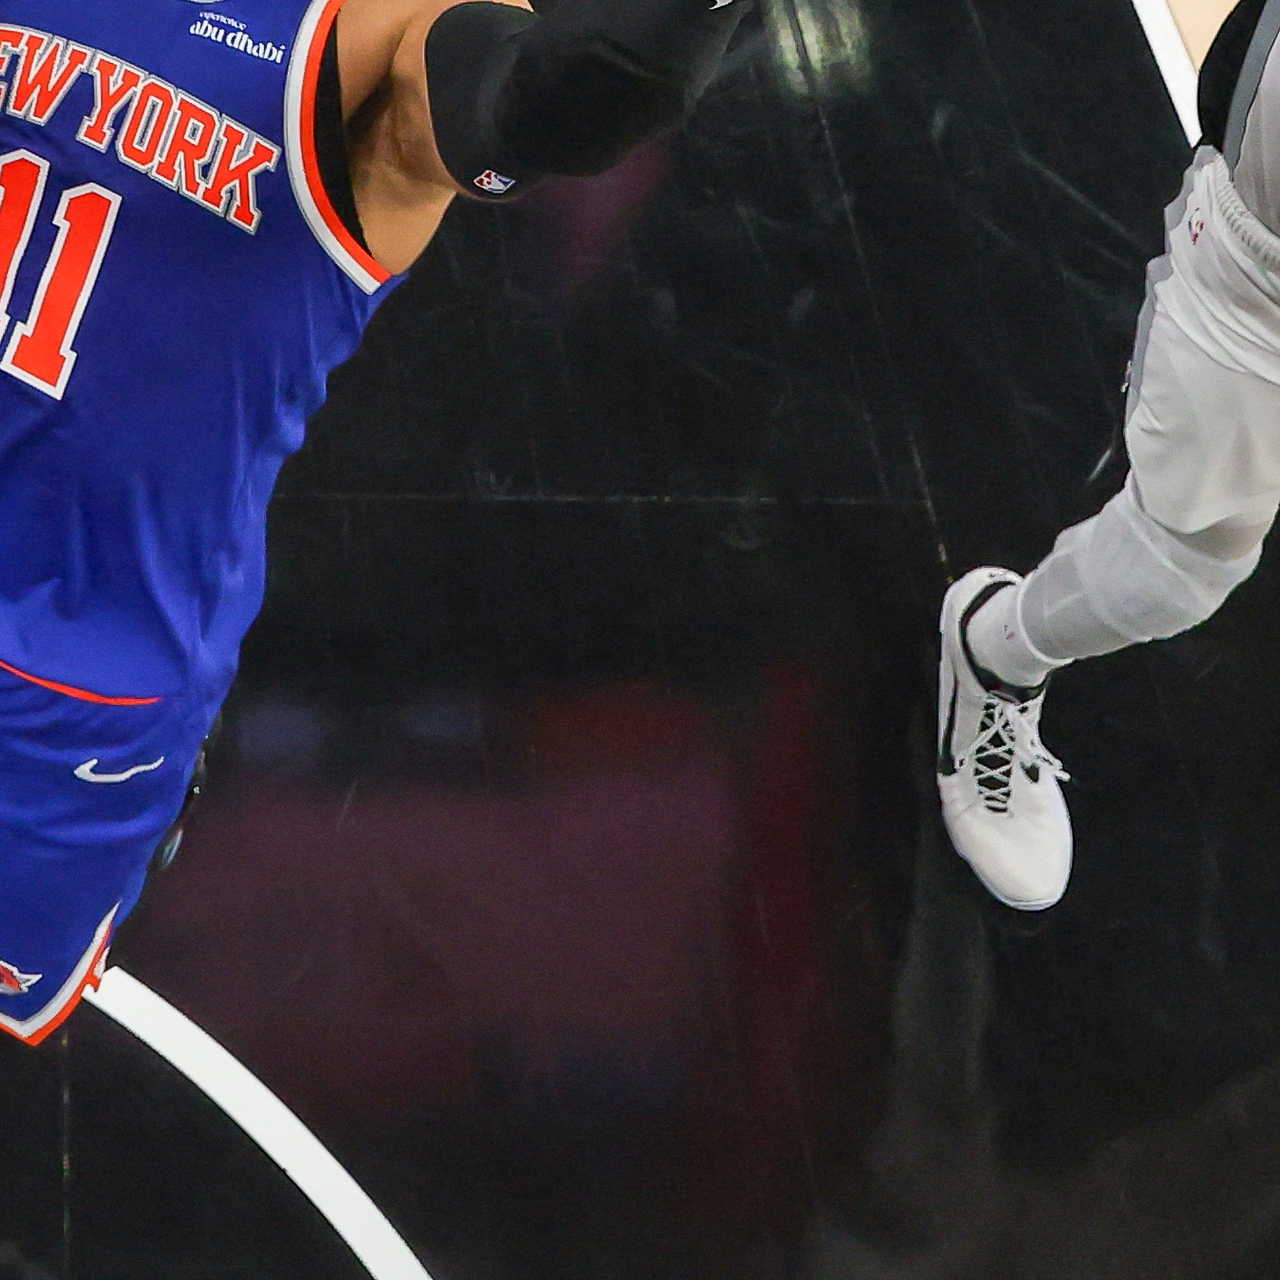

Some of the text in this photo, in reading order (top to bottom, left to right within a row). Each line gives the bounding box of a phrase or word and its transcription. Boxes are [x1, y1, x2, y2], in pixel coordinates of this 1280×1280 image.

[189, 20, 286, 64] abu dhabi
[76, 49, 282, 235] YORK
